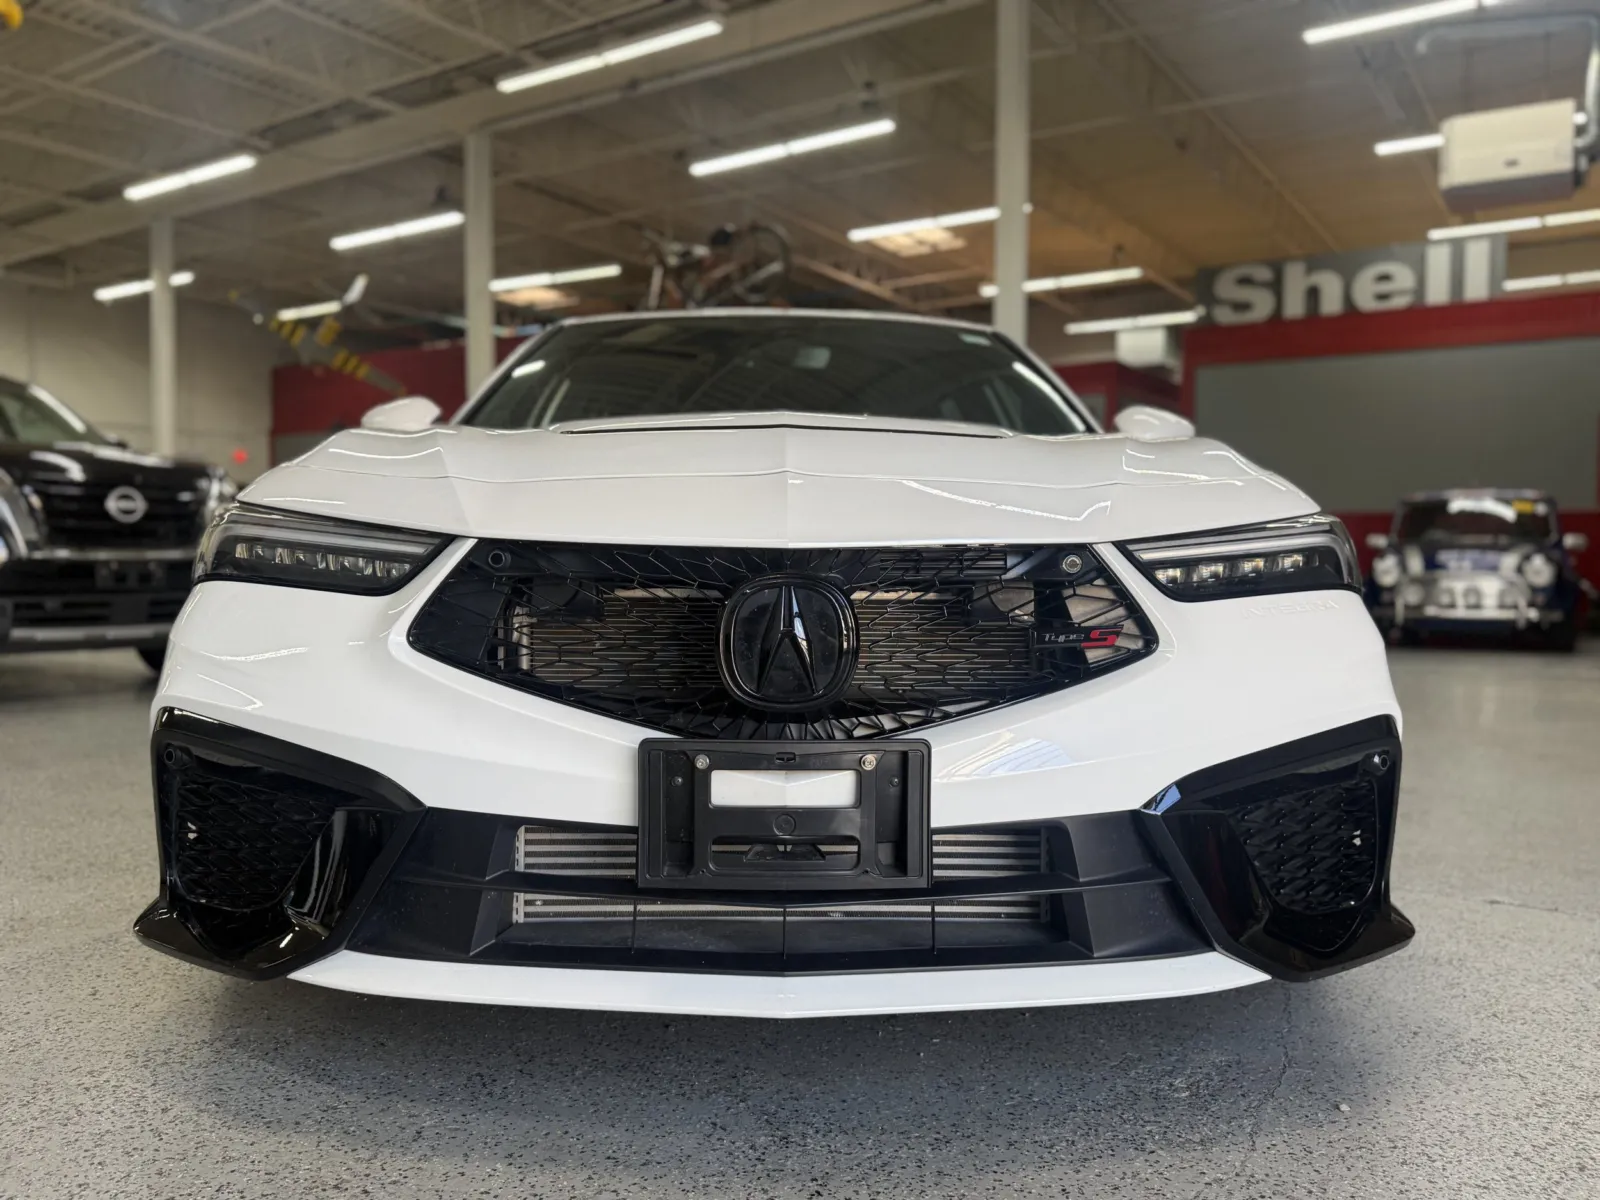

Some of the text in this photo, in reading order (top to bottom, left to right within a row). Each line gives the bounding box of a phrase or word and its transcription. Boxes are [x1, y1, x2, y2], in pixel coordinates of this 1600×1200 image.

[1210, 237, 1491, 325] Shell
[1041, 627, 1124, 648] Type S
